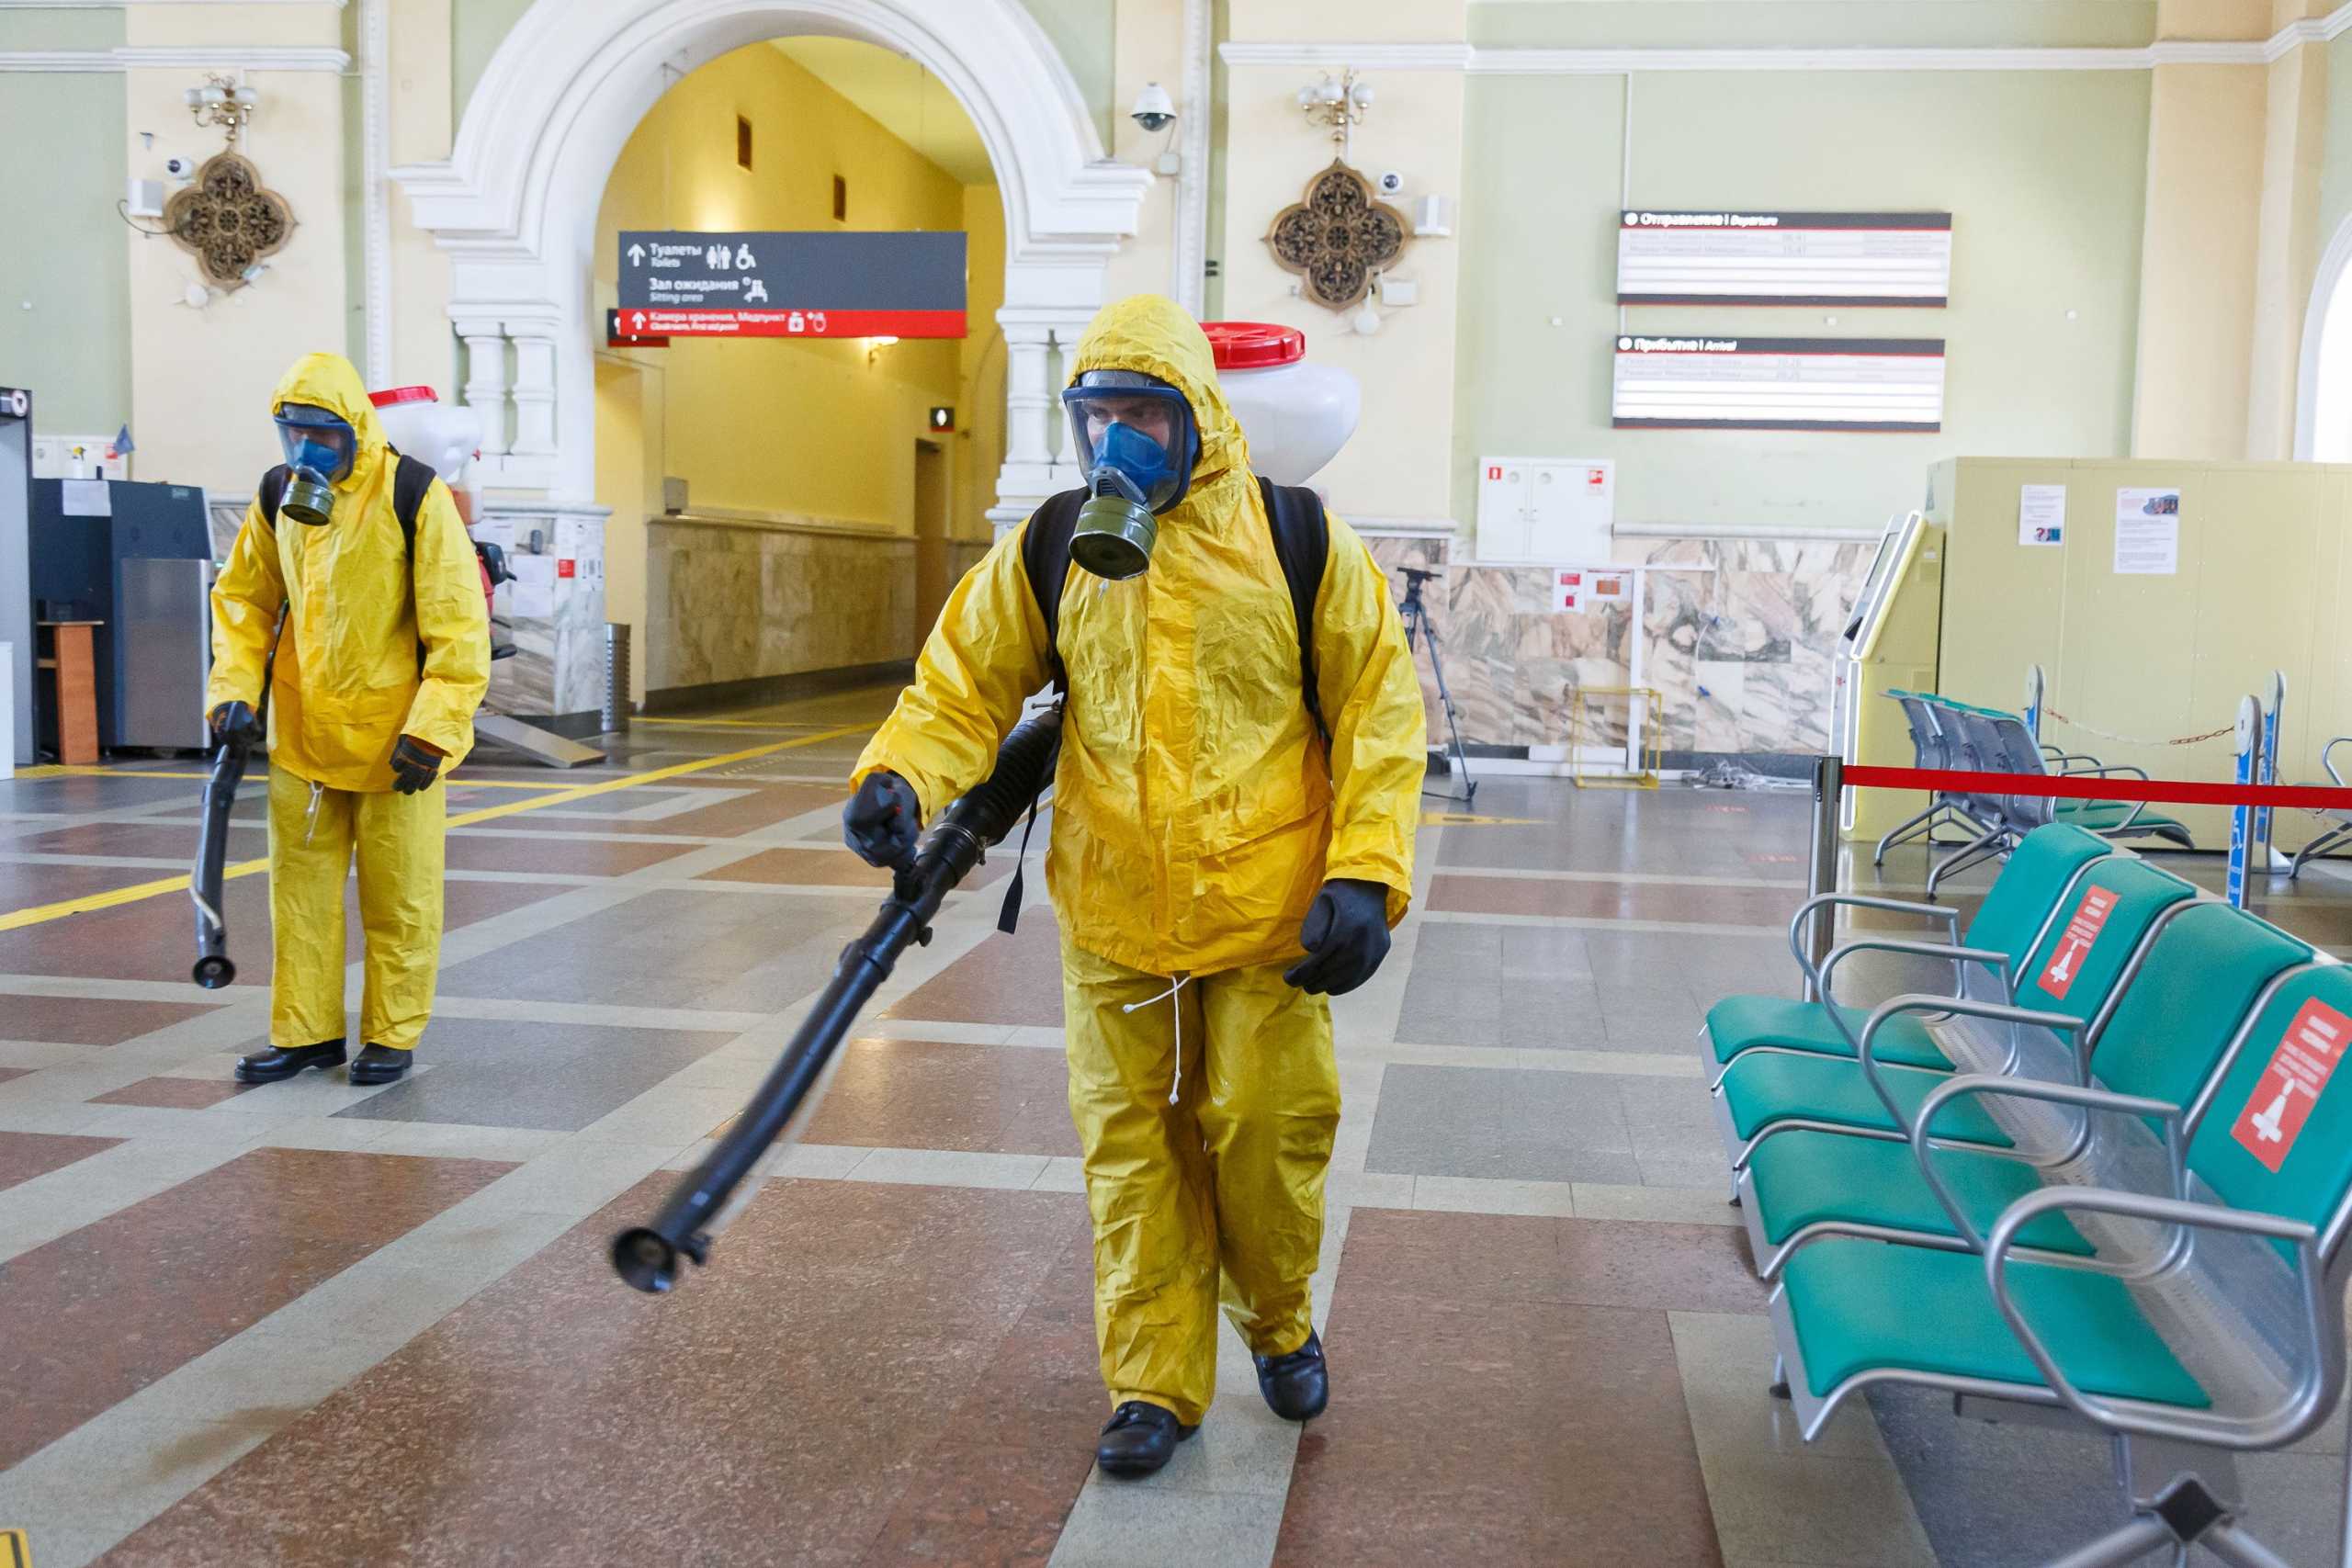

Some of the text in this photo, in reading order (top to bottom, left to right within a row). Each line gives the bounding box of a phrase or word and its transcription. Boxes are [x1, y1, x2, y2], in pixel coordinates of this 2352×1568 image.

[650, 243, 702, 258] Туалеты
[650, 277, 740, 292] Зал ожидания
